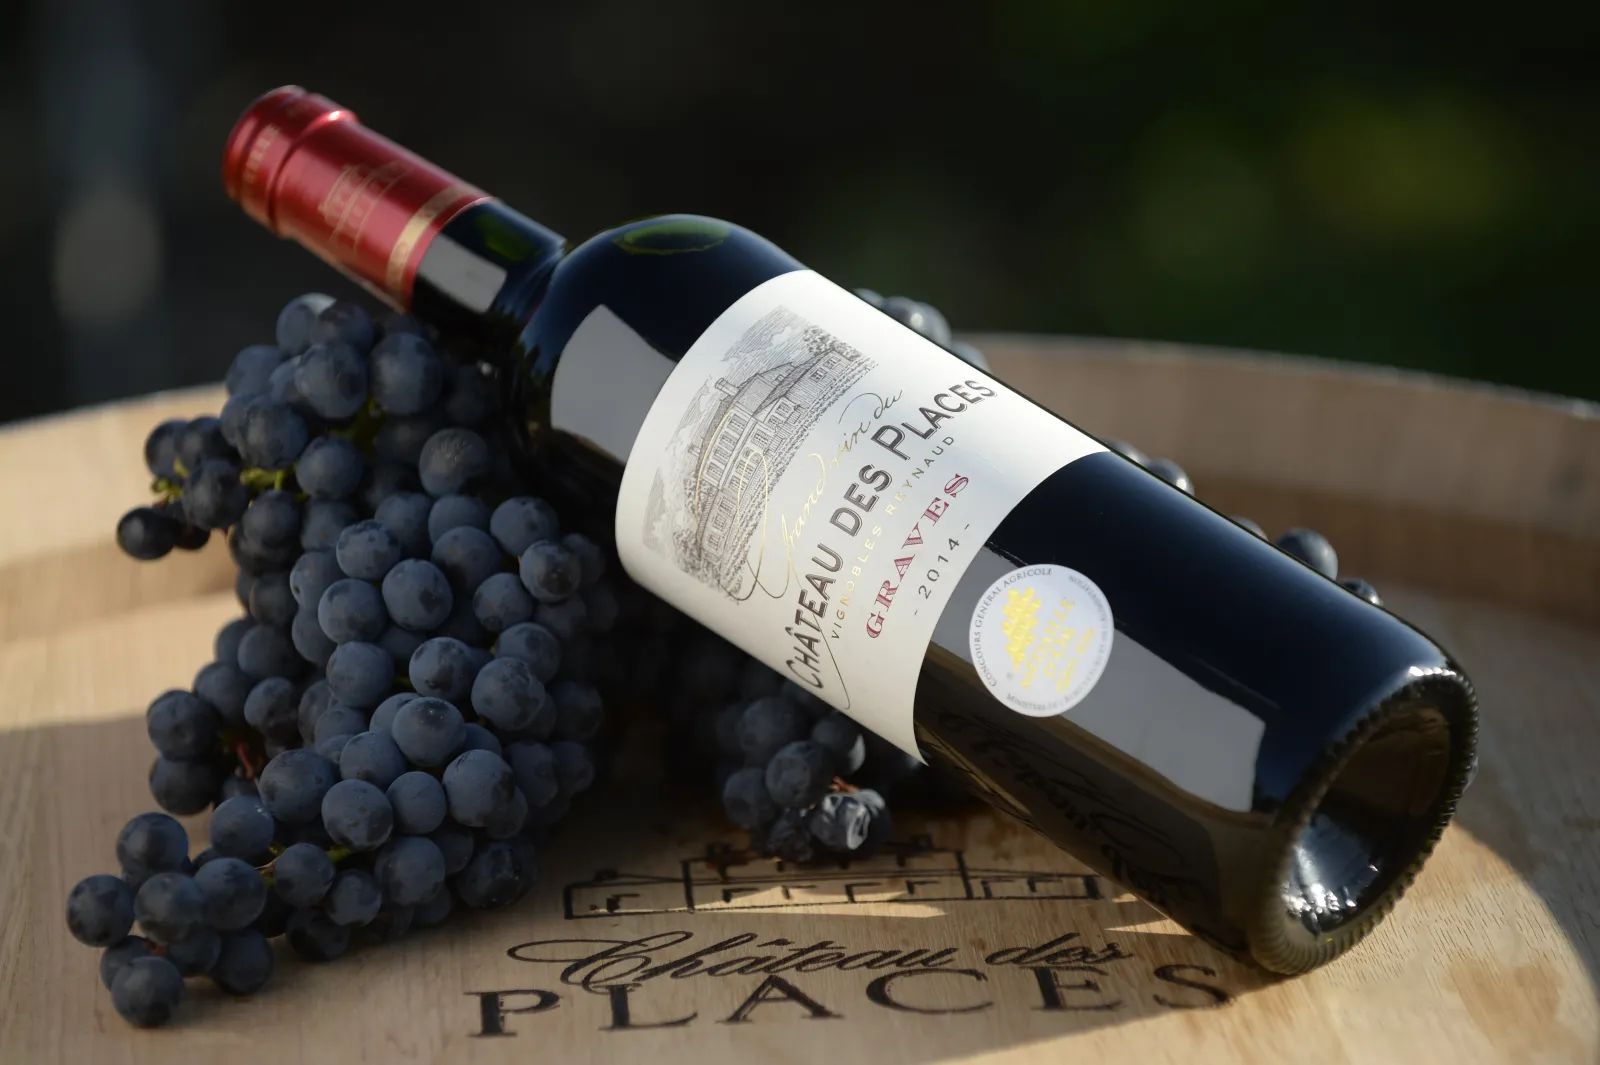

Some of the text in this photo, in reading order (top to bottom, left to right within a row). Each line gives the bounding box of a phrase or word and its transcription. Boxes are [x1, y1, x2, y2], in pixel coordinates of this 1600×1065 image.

[786, 379, 999, 689] CHÂTEAU DES PLACES
[831, 435, 955, 640] VIGNOBLES REYNAUD
[865, 473, 970, 639] GRAVES
[917, 537, 960, 600] 2014
[973, 631, 998, 687] CONCOURS
[1003, 567, 1053, 588] AGRICOLE
[463, 963, 1236, 1038] PLACES
[506, 931, 1133, 995] Château des
